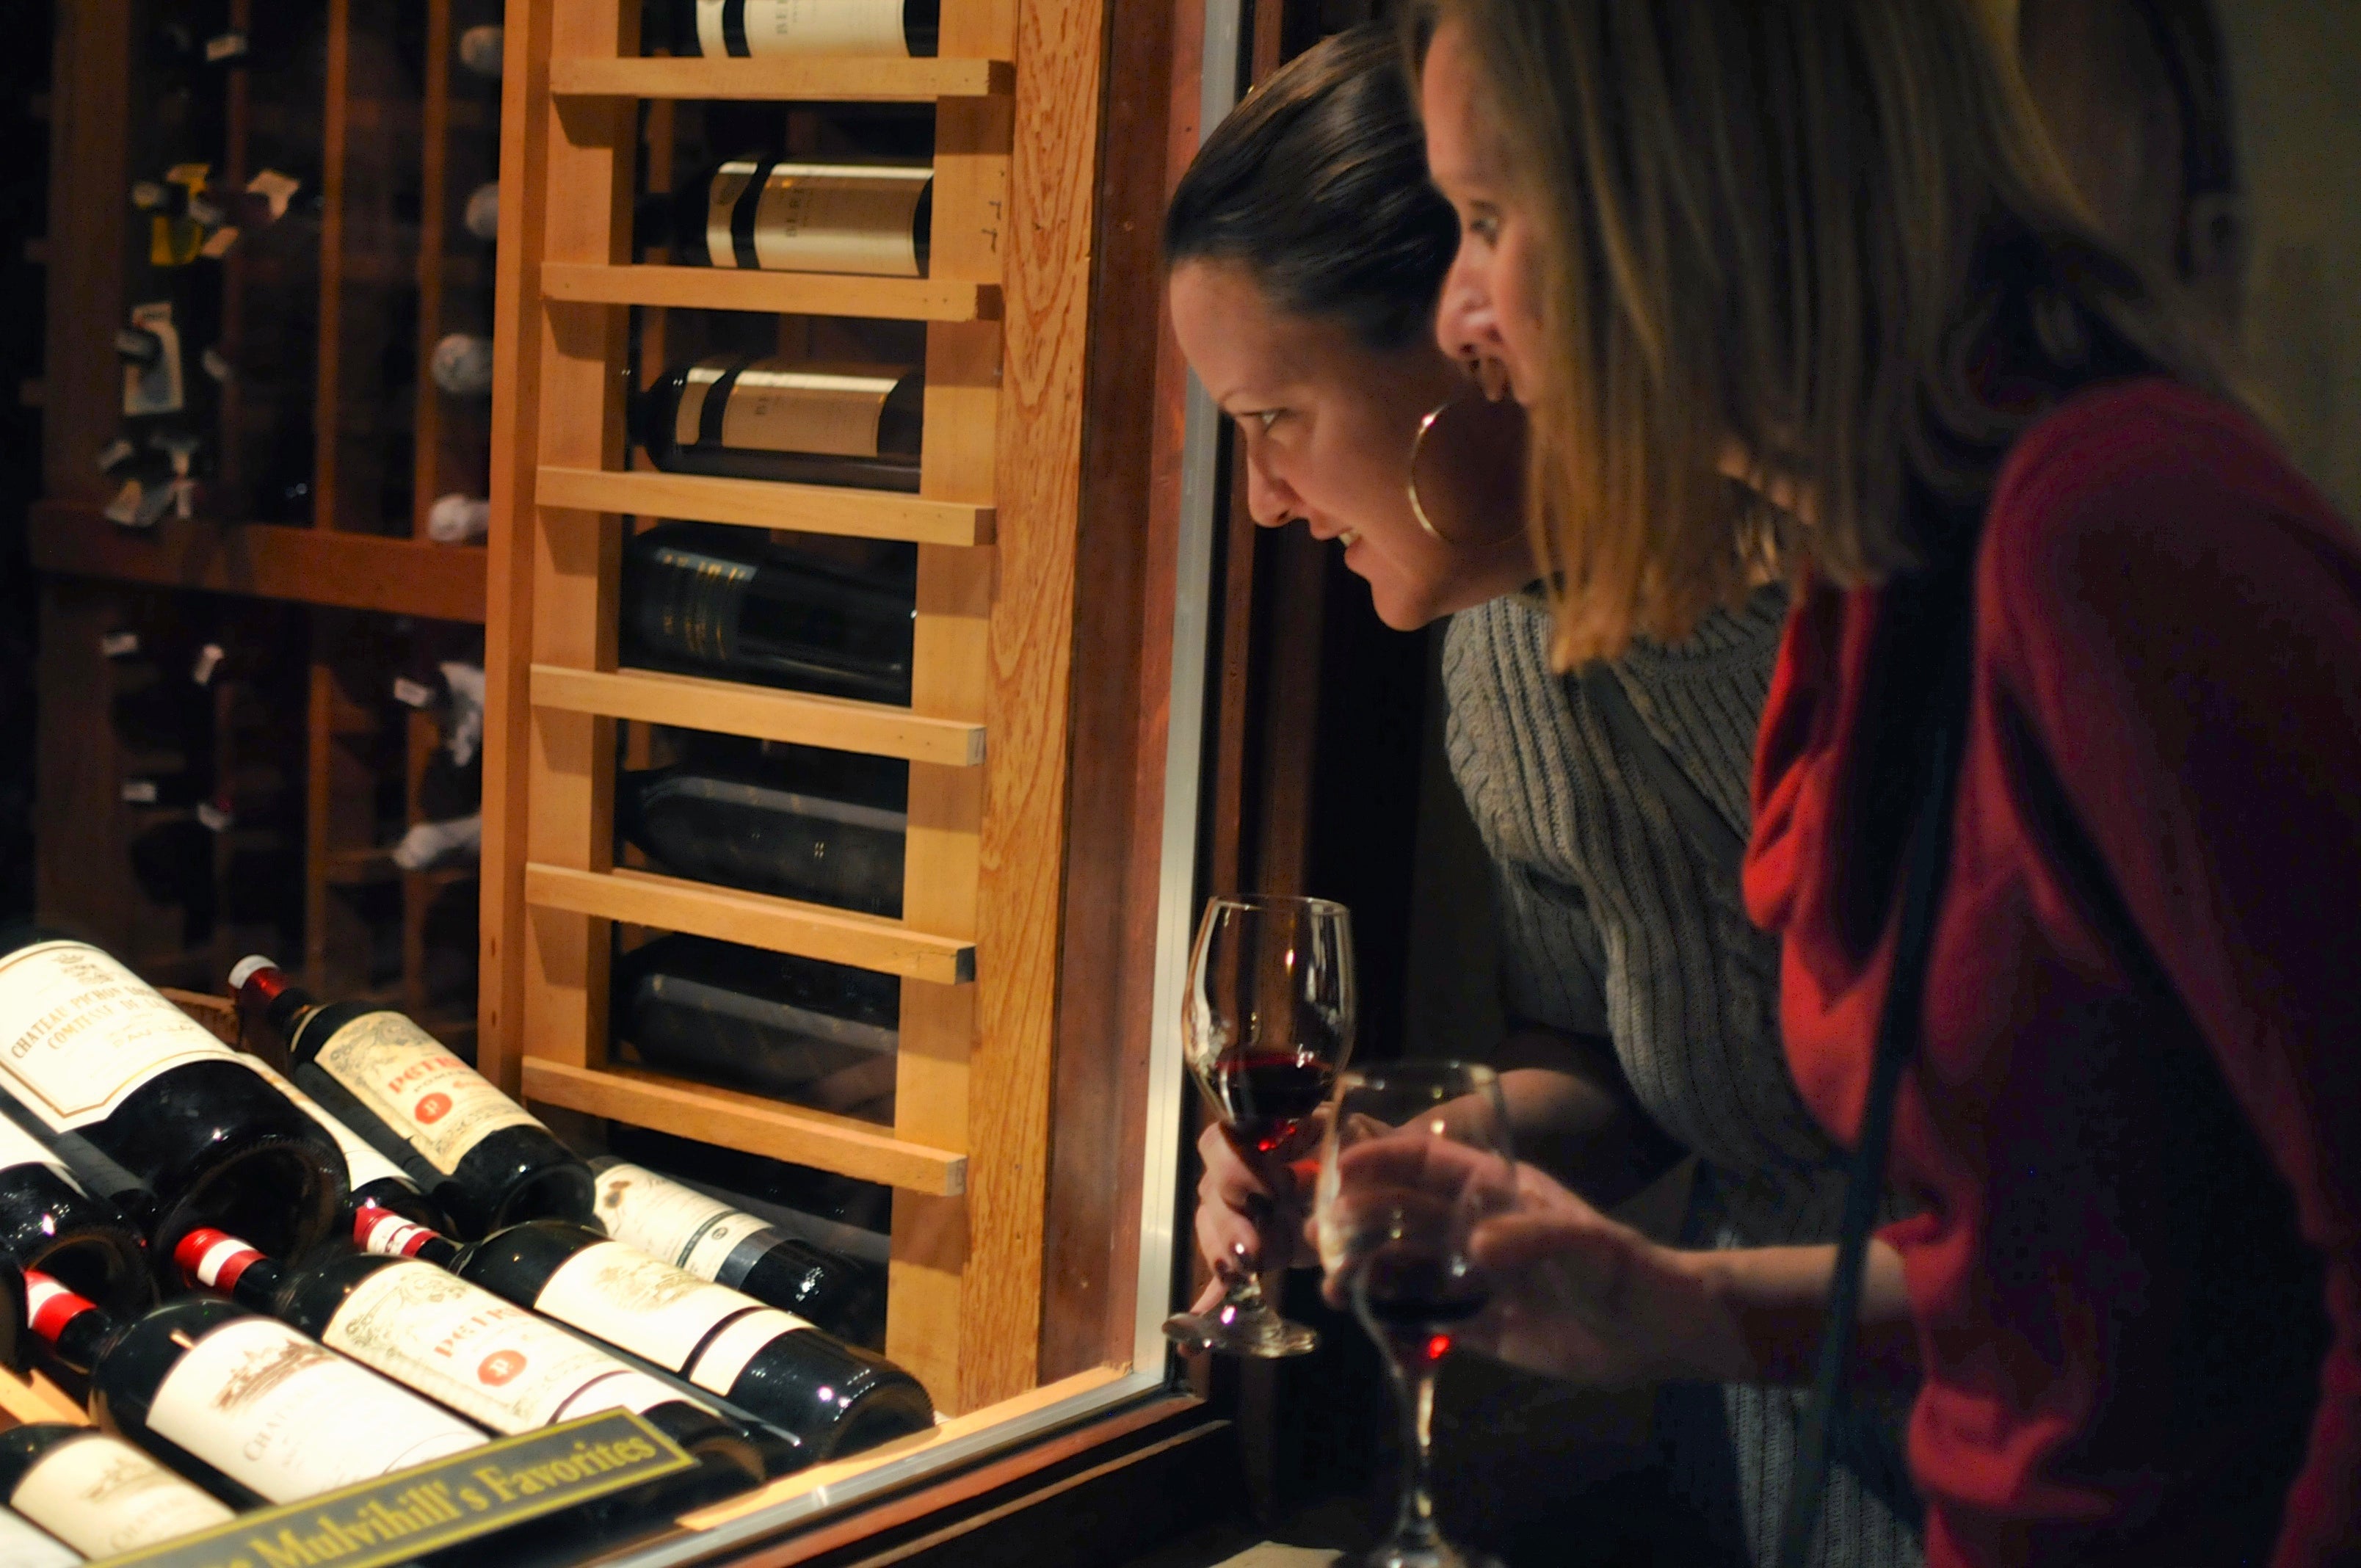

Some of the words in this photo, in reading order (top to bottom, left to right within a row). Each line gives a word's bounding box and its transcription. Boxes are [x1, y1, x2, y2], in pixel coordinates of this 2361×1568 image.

[10, 1005, 70, 1059] CHATEAU
[433, 1307, 529, 1358] PETR
[248, 1480, 488, 1568] Mulvihill's
[472, 1434, 658, 1503] Favorites
